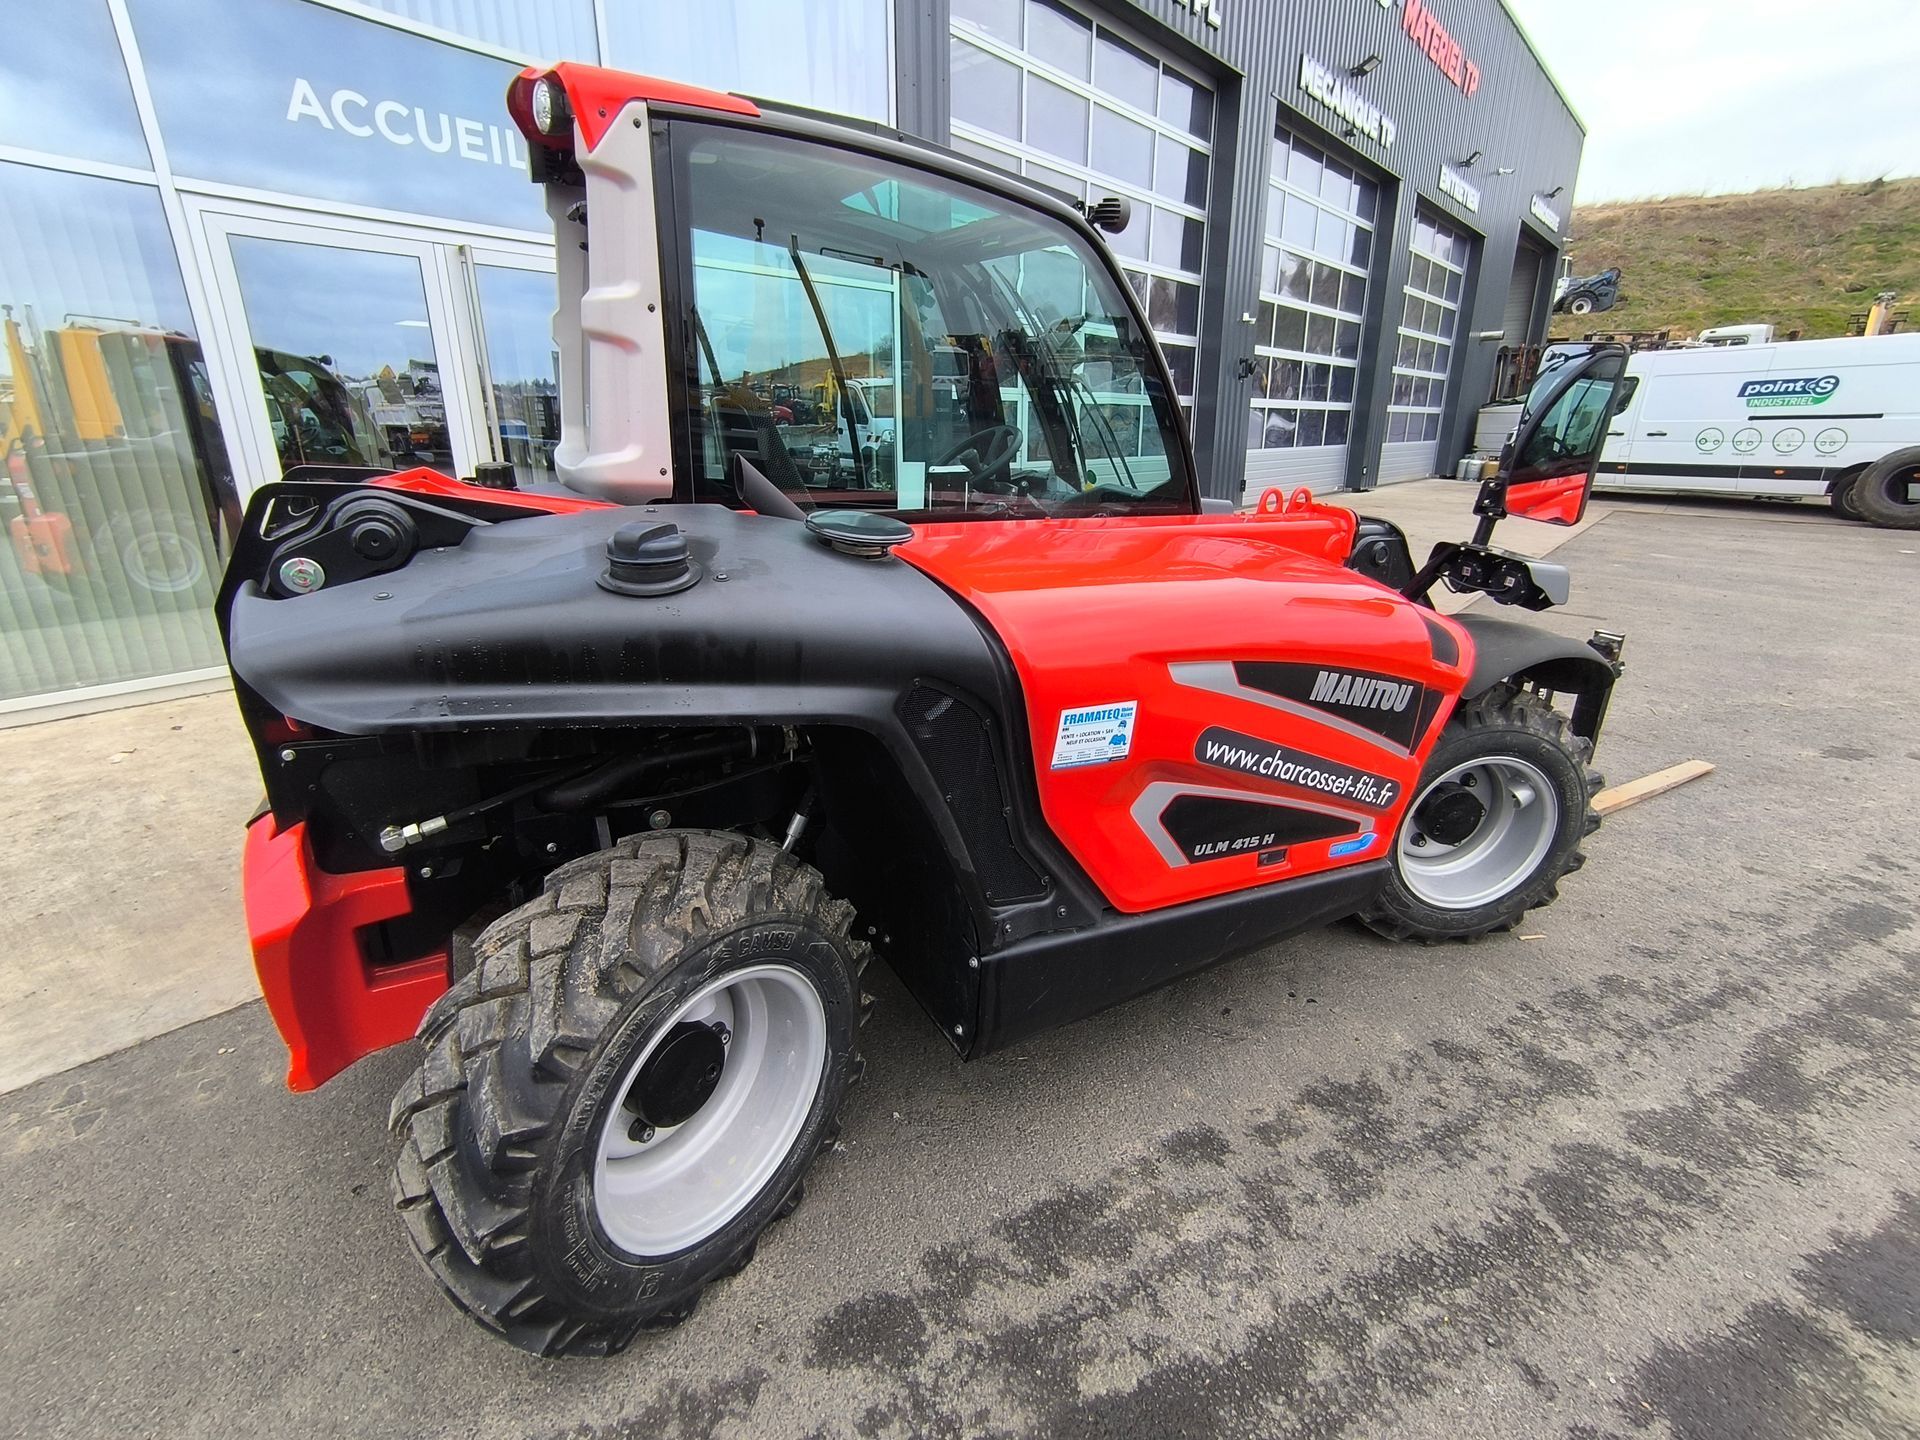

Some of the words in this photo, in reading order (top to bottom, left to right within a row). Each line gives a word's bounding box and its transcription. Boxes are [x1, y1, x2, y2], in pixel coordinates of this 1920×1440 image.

[1402, 0, 1462, 88] MATERIEL
[1463, 58, 1480, 99] TP
[1299, 52, 1381, 141] MECANIQUE
[1380, 112, 1396, 150] TP
[286, 77, 527, 170] ACCUEIL
[1744, 380, 1805, 396] point
[1749, 396, 1815, 408] INDUSTRIEL
[1309, 670, 1414, 713] MANITOU
[1063, 707, 1120, 726] FRAMATEQ
[1079, 729, 1101, 738] LOCATION
[1084, 736, 1106, 744] OCCASION
[1205, 740, 1394, 806] www.charcosset-fils.fr
[1194, 841, 1230, 856] ULM
[1231, 835, 1260, 851] 415
[1261, 833, 1276, 846] H
[738, 930, 797, 958] CAMSO
